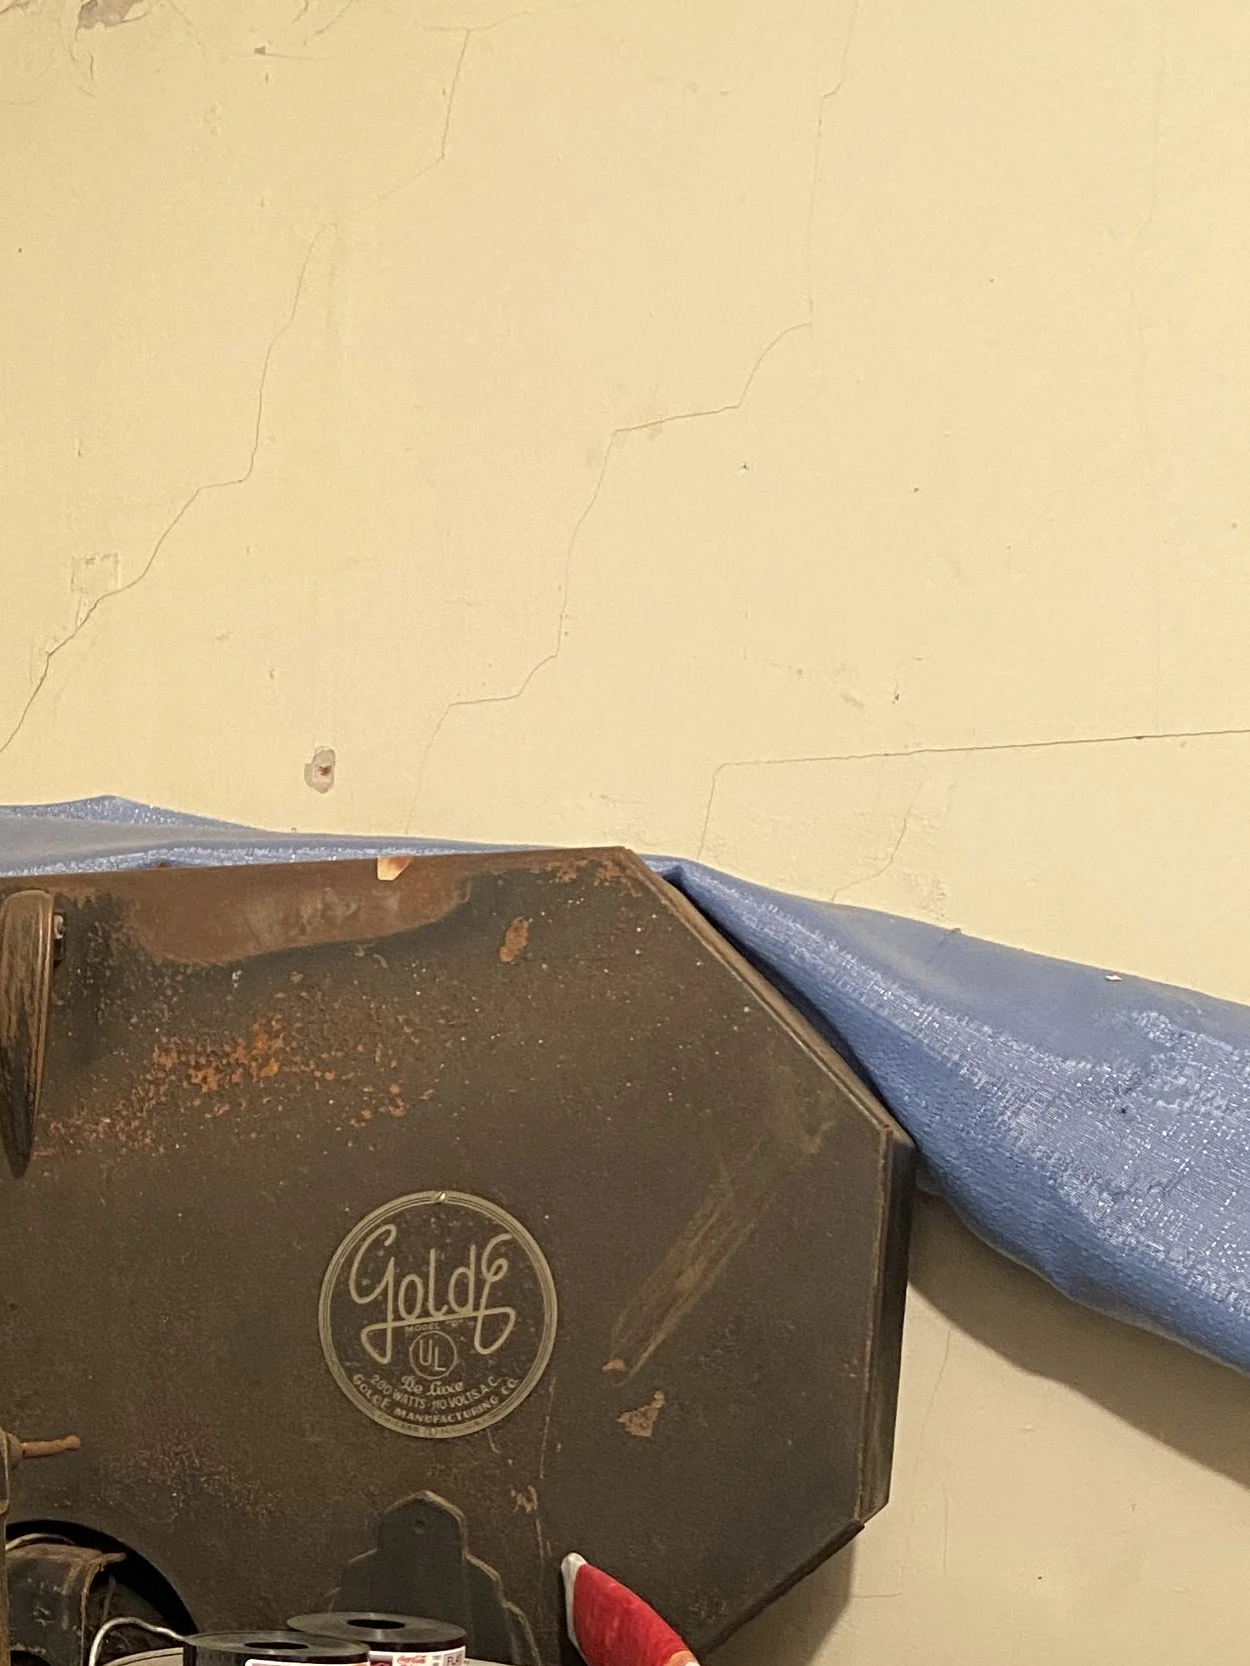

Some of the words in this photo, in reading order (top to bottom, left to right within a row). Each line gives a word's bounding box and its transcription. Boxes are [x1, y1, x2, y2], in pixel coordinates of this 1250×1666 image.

[419, 1339, 447, 1372] UL
[401, 1375, 423, 1394] De
[426, 1381, 465, 1396] Luxe
[394, 1395, 500, 1424] MANUFACTURING
